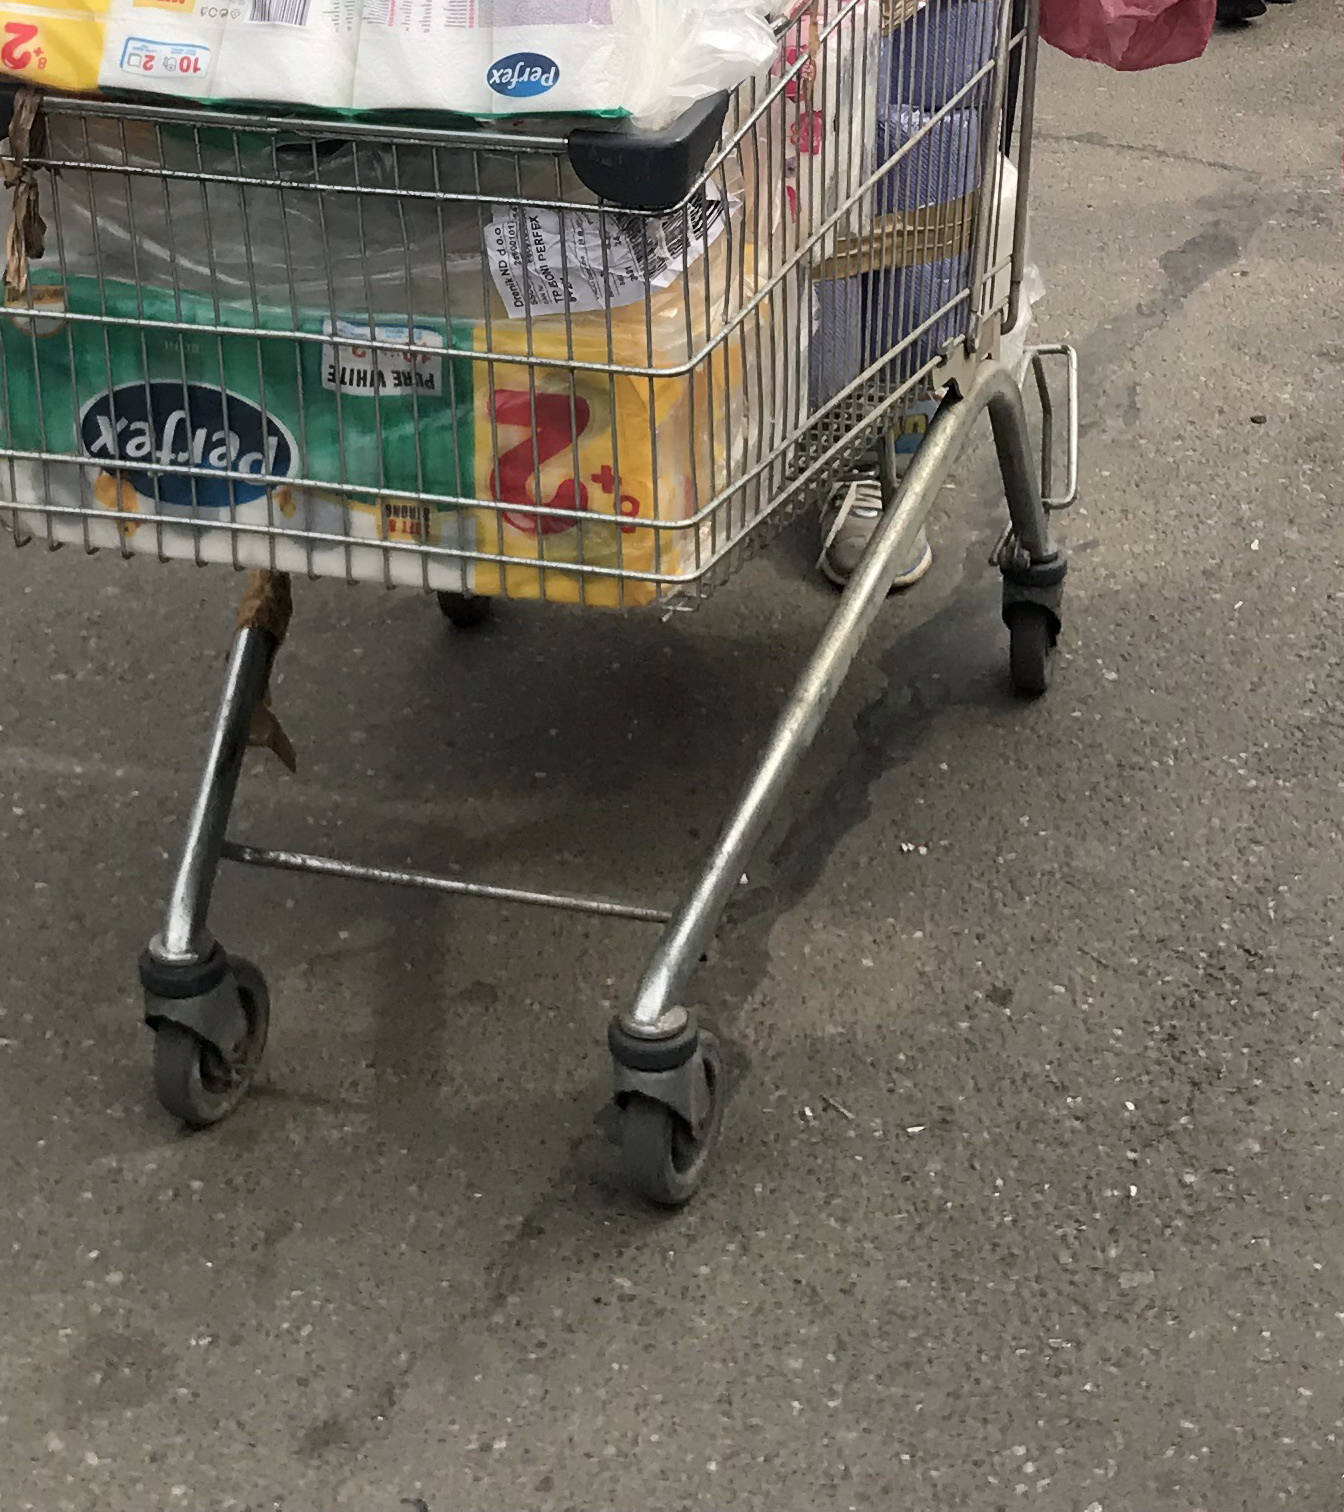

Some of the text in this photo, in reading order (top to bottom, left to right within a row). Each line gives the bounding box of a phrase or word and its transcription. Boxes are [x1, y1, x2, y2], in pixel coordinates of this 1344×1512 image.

[142, 54, 201, 74] 10 2
[489, 65, 556, 89] Perfex
[528, 214, 547, 262] PERFEX
[498, 260, 511, 276] ND
[542, 264, 560, 288] BONI
[551, 289, 565, 303] TP
[327, 364, 435, 390] PURE WHITE
[90, 409, 279, 485] Perfex
